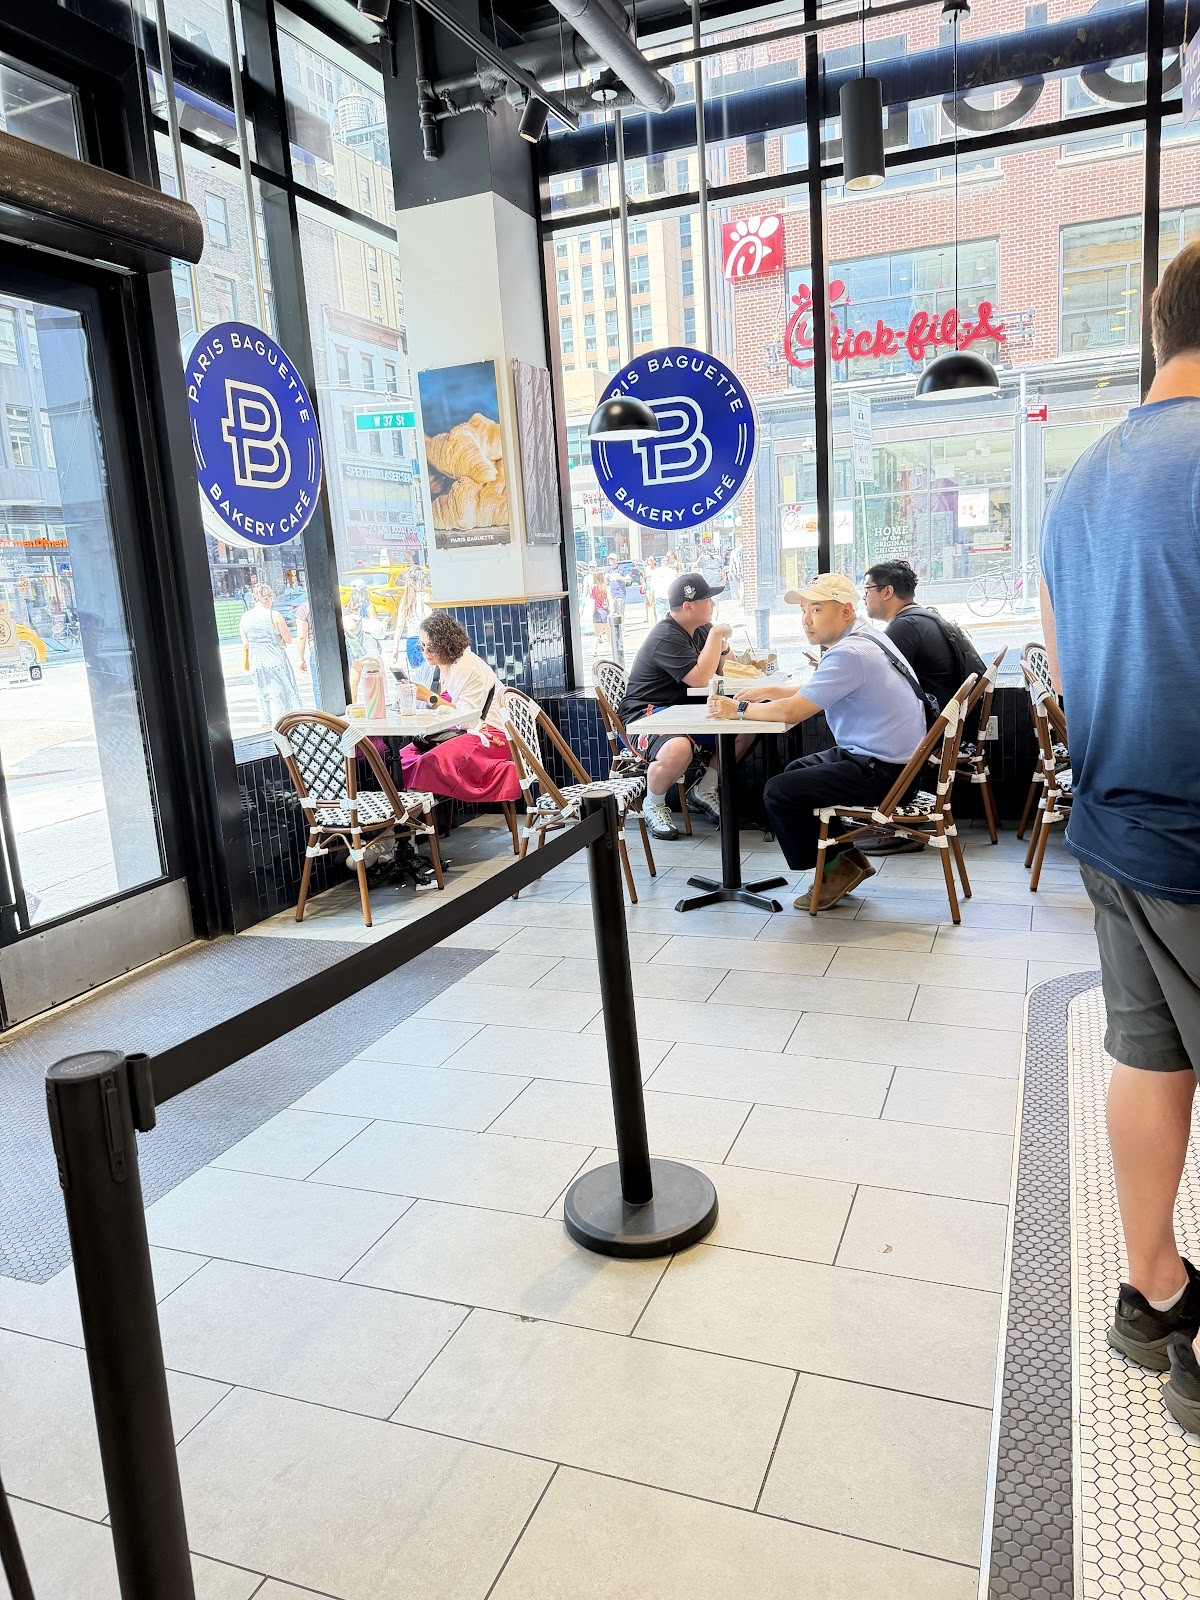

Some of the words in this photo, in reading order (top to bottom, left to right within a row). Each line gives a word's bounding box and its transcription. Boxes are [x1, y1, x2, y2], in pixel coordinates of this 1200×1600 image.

[188, 338, 224, 403] PARIS
[229, 332, 310, 424] BAGUETTE
[647, 355, 744, 413] BAGUETTE
[373, 416, 381, 428] W
[383, 415, 393, 427] 37
[395, 414, 405, 427] St
[614, 487, 685, 523] BAKERY
[692, 473, 736, 516] CAFÉ
[210, 482, 275, 537] BAKERY
[280, 489, 310, 533] CAFÉ
[874, 525, 909, 537] HOME
[450, 536, 466, 544] PARIS
[467, 534, 495, 542] BAGUETTE
[874, 540, 909, 548] ORIGINAL
[874, 552, 909, 560] SANDWICH
